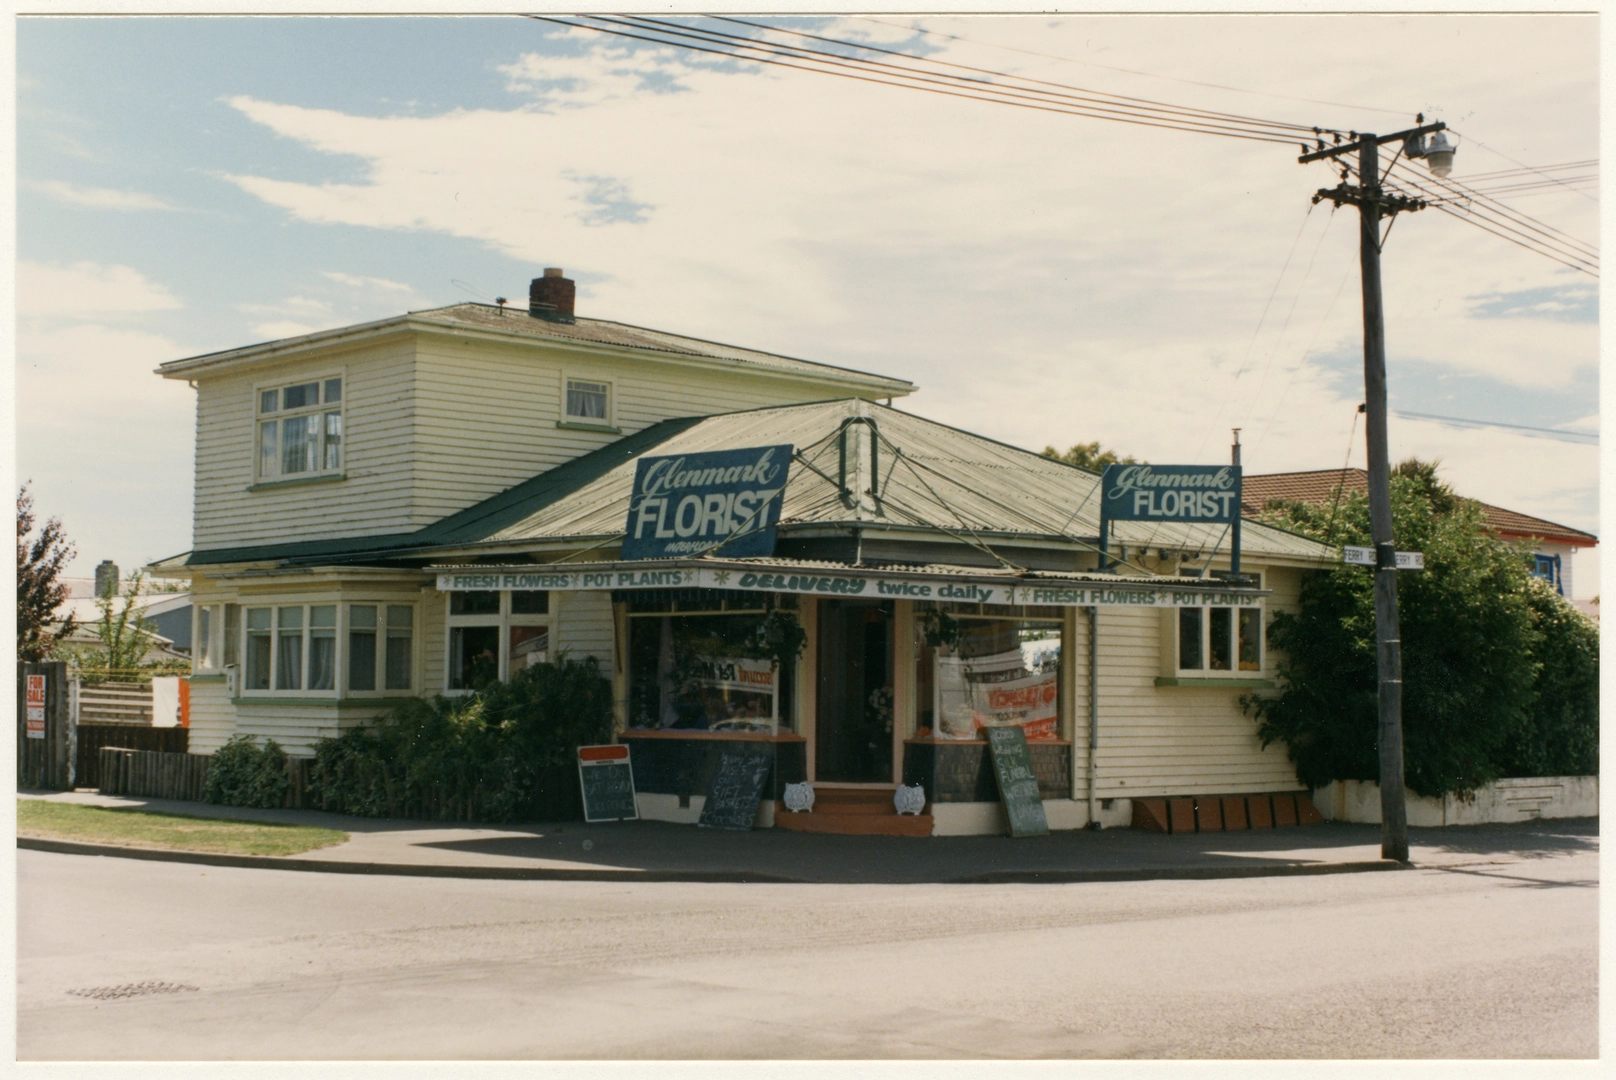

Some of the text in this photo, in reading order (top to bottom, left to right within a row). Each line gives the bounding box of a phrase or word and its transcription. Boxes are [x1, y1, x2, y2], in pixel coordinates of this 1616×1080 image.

[631, 448, 780, 511] Glenmark
[1108, 466, 1235, 499] Glenmark
[1133, 490, 1236, 518] FLORIST
[634, 488, 781, 539] FLORIST
[1344, 549, 1363, 561] FERRY
[1395, 555, 1411, 566] ERRY
[453, 574, 570, 588] FRESH FLOWERS
[583, 571, 682, 587] POT PLANTS
[738, 572, 994, 603] DELIVERY twice daily
[1033, 589, 1156, 605] FRESH FLOWERS
[1172, 591, 1252, 606] POT PLANTS
[29, 676, 43, 689] FOR
[27, 690, 45, 703] SALE
